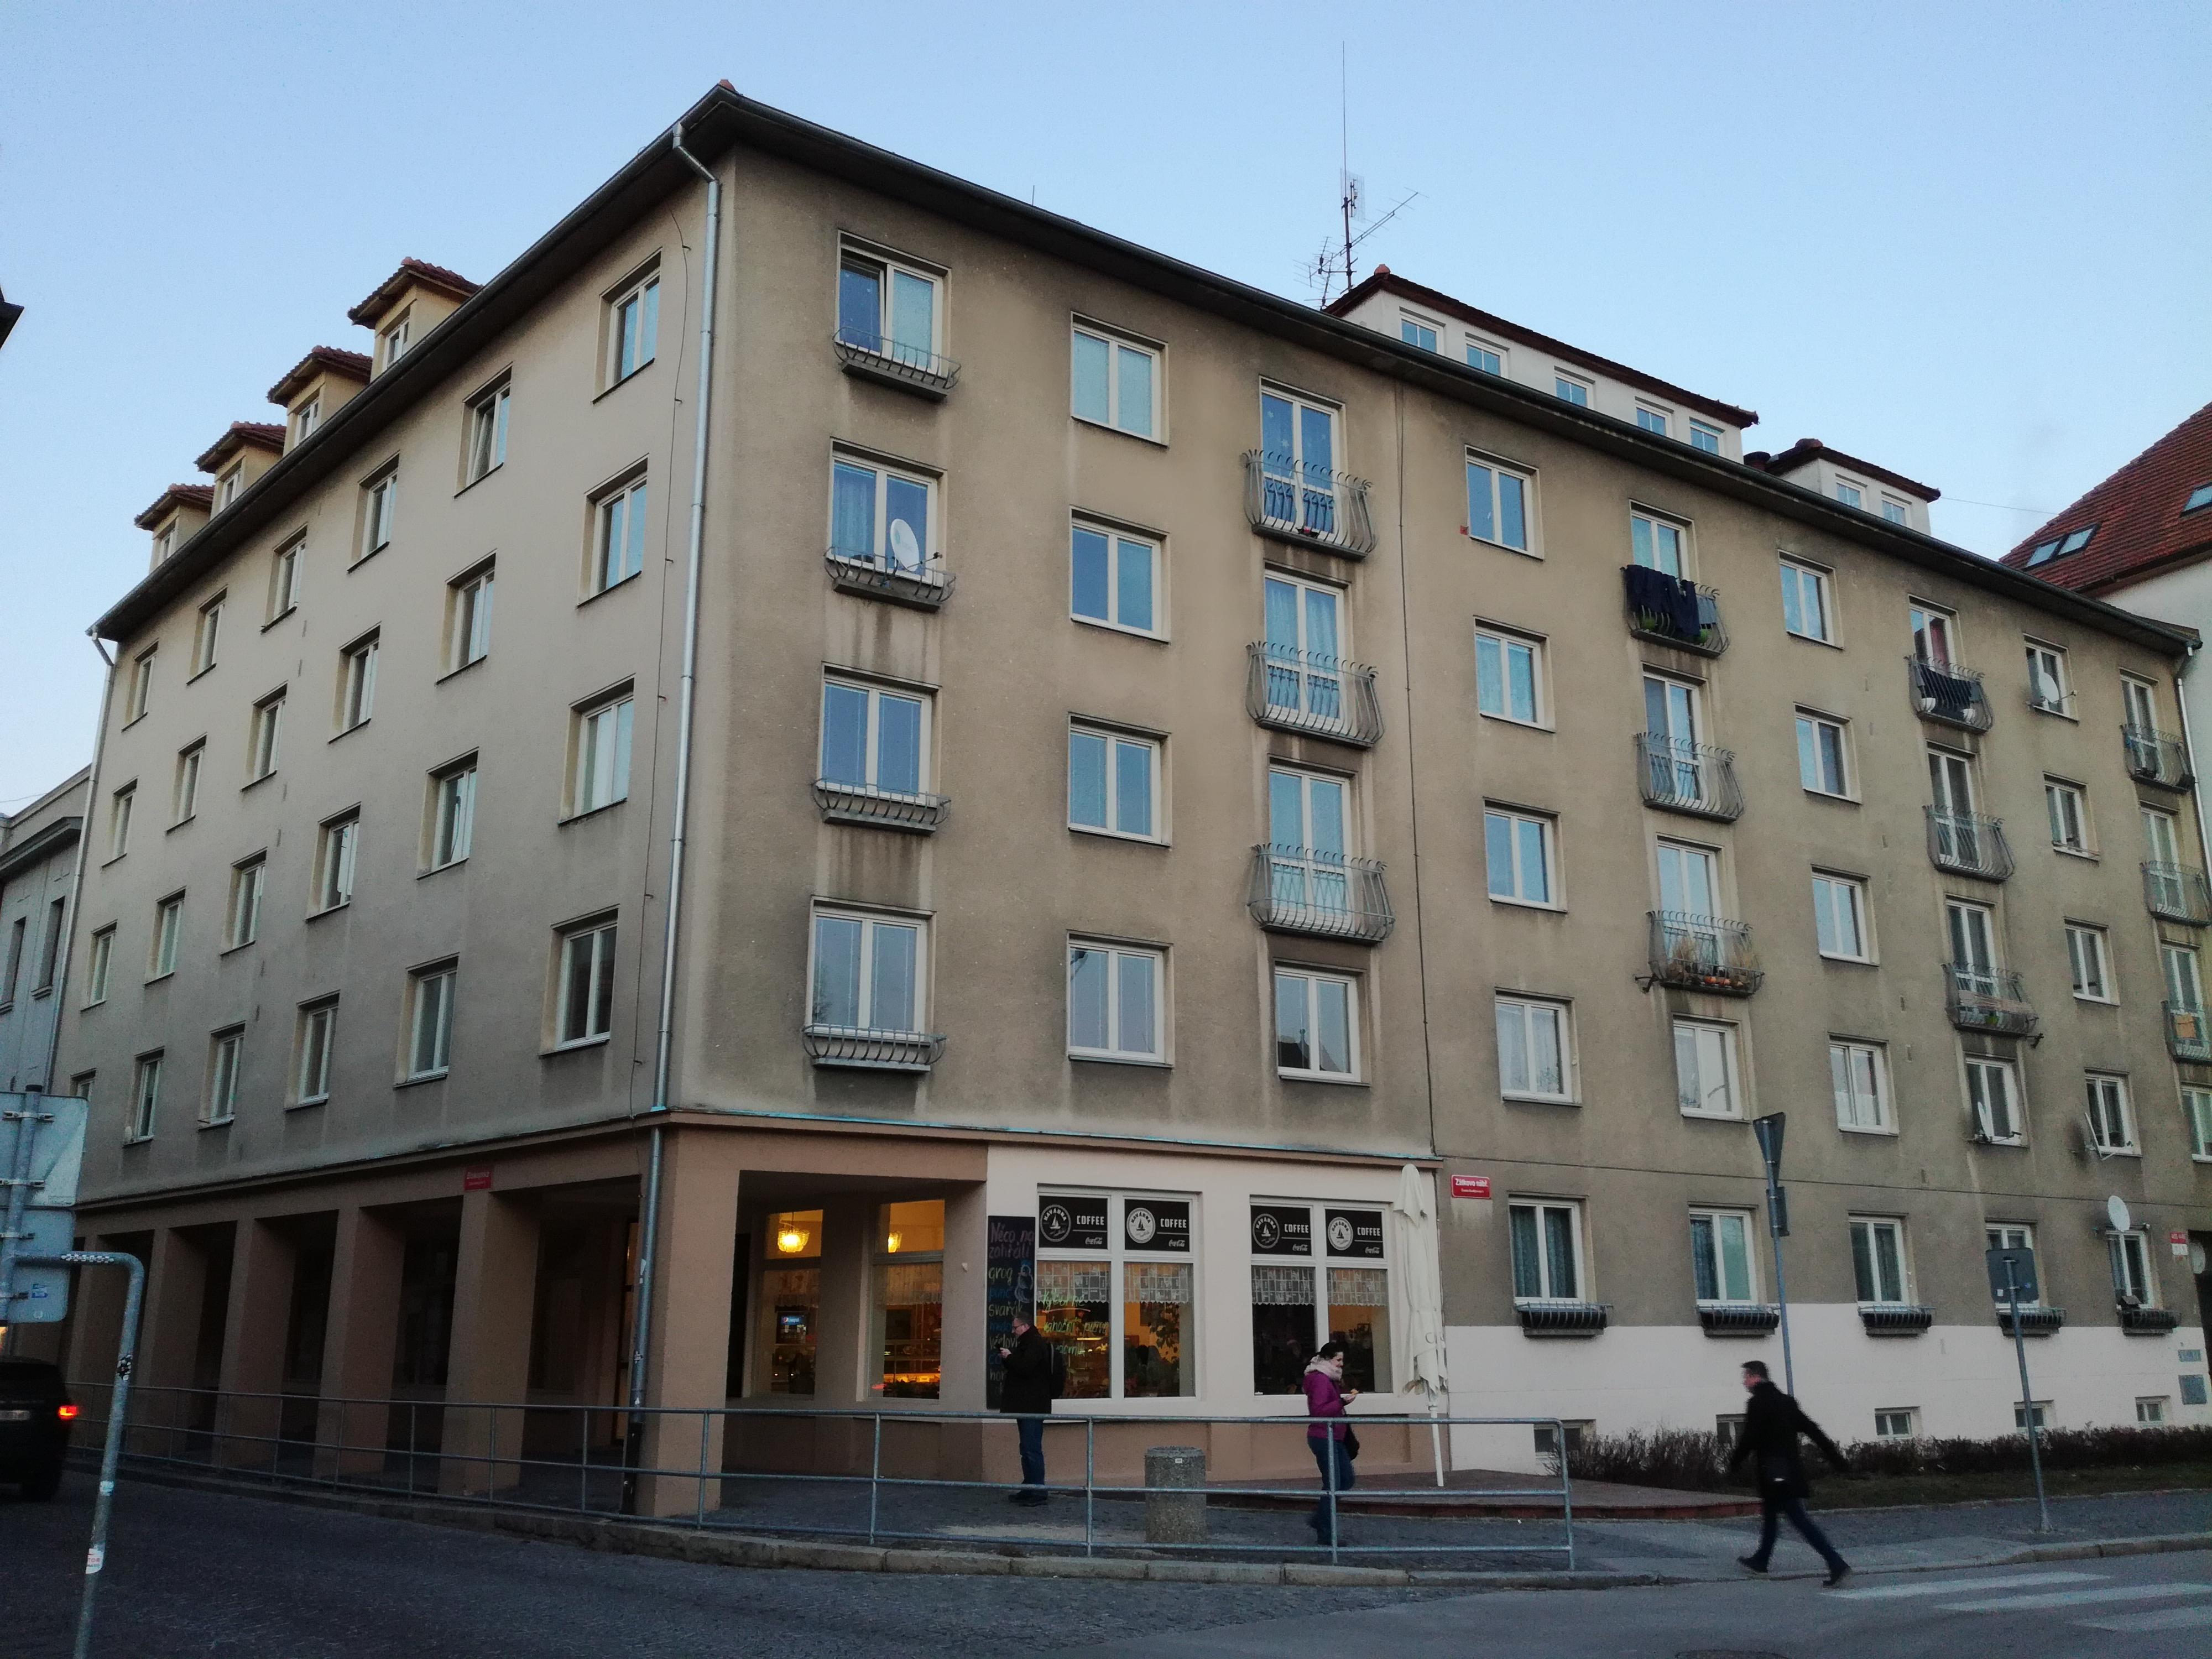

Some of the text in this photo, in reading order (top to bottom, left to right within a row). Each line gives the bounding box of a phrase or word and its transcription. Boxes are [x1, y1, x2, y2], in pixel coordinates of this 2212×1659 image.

[1076, 1214, 1105, 1226] COFFEE
[1160, 1218, 1187, 1229] COFFEE
[1284, 1223, 1310, 1234] COFFEE
[1357, 1227, 1381, 1237] COFFEE
[988, 1266, 1013, 1286] grog
